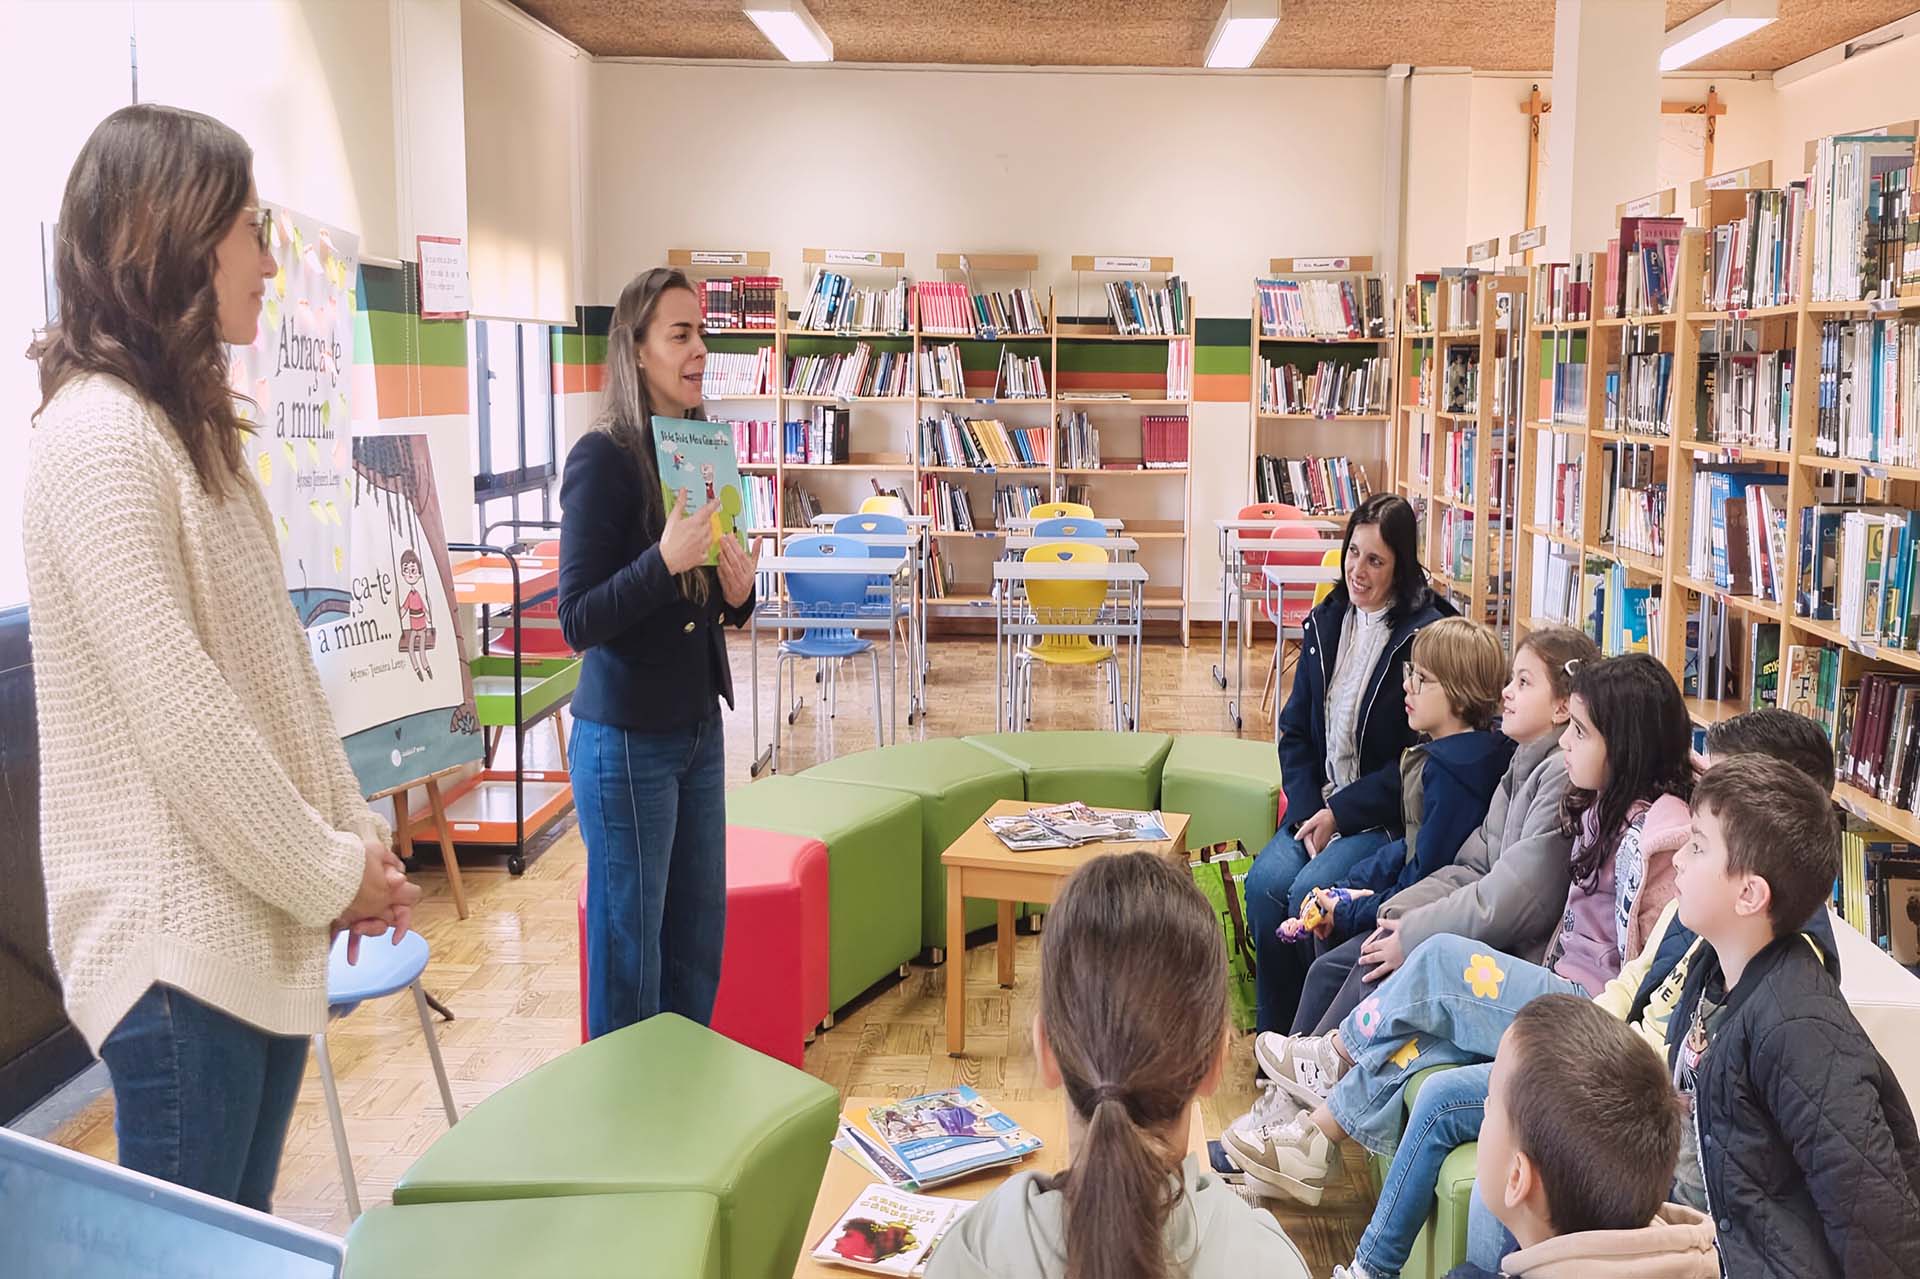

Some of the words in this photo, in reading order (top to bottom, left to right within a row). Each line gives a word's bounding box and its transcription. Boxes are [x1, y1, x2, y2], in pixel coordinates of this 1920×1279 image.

[274, 312, 342, 391] Abraçate
[276, 400, 286, 439] a
[318, 631, 330, 654] a
[334, 610, 393, 650] mim...
